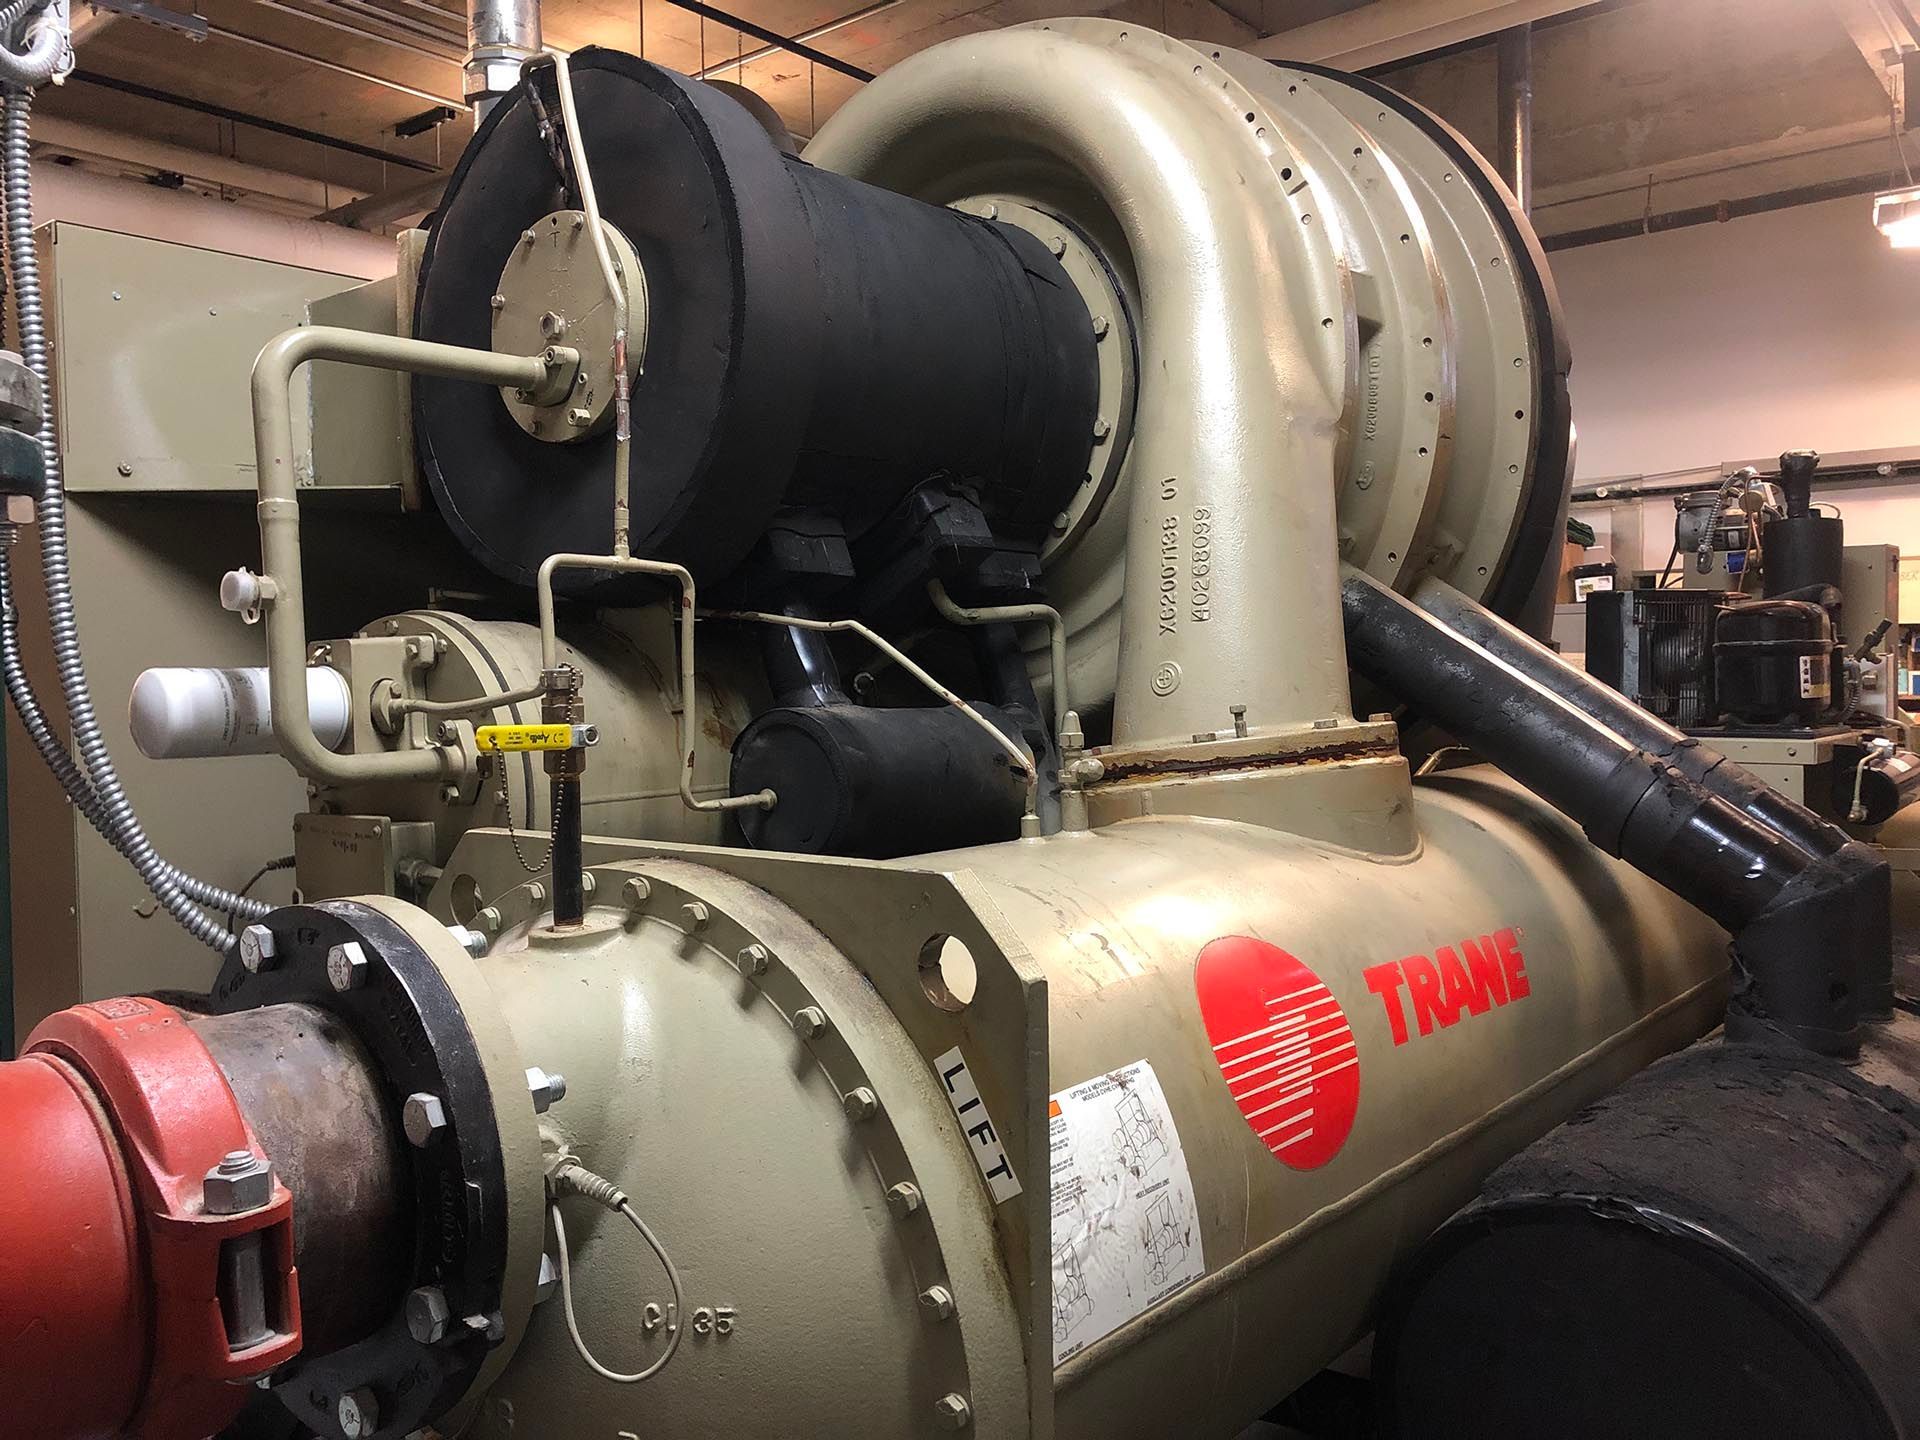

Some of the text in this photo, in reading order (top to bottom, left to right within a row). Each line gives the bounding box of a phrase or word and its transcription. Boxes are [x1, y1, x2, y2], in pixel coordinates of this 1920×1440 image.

[1160, 477, 1178, 501] 01
[1362, 928, 1532, 1047] TRANE
[943, 1062, 1013, 1180] LIFT
[693, 1306, 736, 1335] 35
